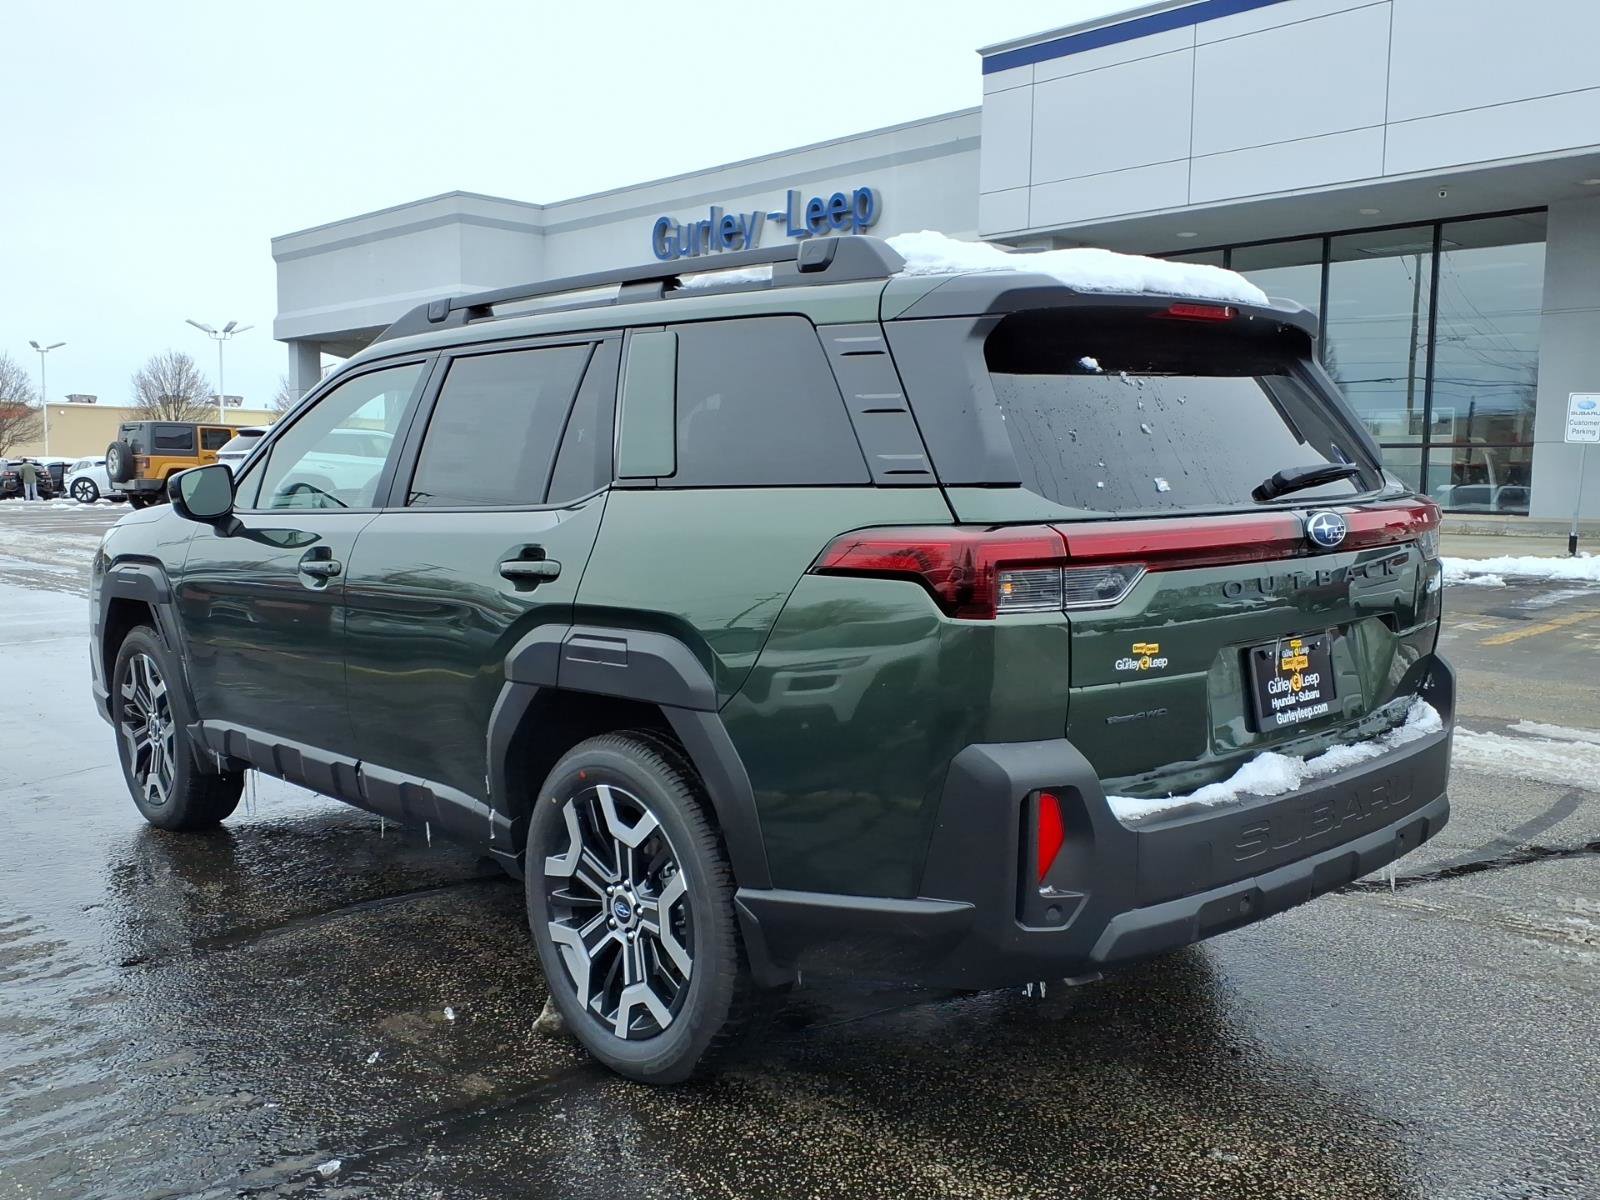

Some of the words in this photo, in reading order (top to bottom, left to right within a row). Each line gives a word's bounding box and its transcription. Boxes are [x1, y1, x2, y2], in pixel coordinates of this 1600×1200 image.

[1571, 428, 1596, 436] Parking
[1222, 560, 1394, 598] OUTBACK
[1115, 658, 1141, 671] Gurley
[1149, 657, 1168, 669] Leep
[1268, 677, 1291, 694] Gurley
[1301, 673, 1320, 687] Leep
[1272, 694, 1296, 710] Hyundai
[1299, 690, 1320, 702] Subaru
[1276, 703, 1328, 724] Gurleyleep.com
[1233, 776, 1416, 862] SUBARU
